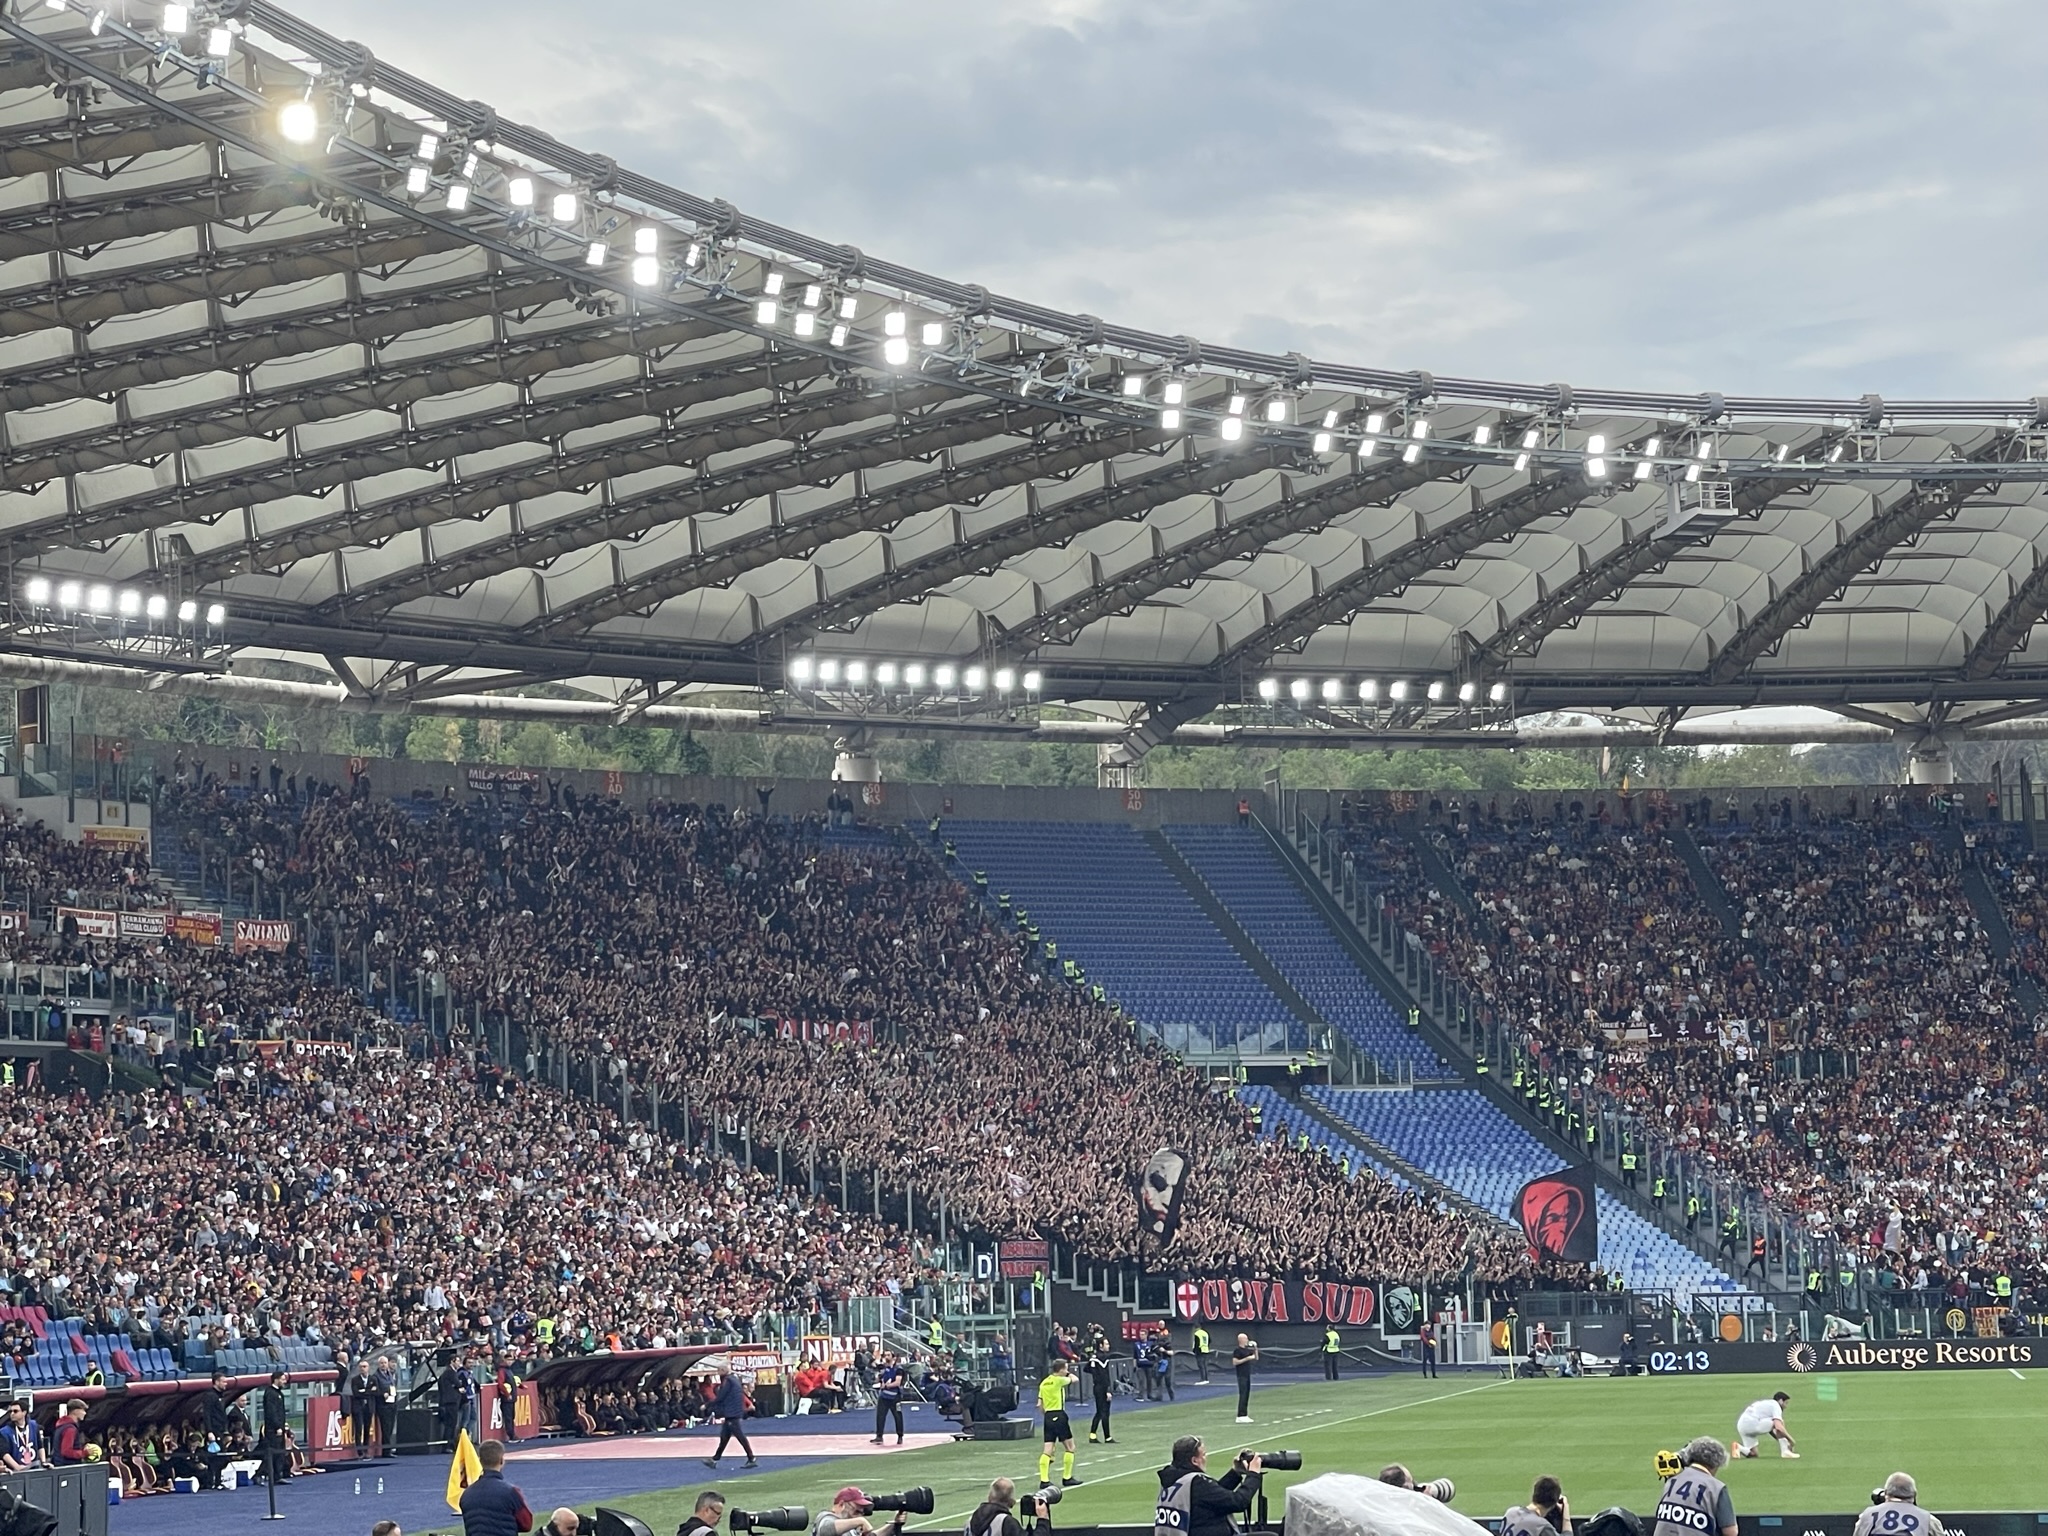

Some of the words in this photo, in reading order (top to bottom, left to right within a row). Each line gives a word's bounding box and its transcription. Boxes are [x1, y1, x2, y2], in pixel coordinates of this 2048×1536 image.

[608, 772, 621, 783] 51
[608, 784, 623, 795] AD
[868, 783, 880, 794] 50
[1128, 790, 1141, 800] 50
[1128, 801, 1142, 811] AD
[237, 921, 290, 942] SAVIANO
[1303, 1282, 1375, 1325] SUD
[1650, 1350, 1710, 1371] 02:13
[1825, 1343, 1929, 1370] Auberge
[1935, 1342, 2032, 1364] Resorts
[1666, 1479, 1707, 1506] 141
[1657, 1503, 1709, 1531] PHOTO
[1871, 1510, 1920, 1532] 189
